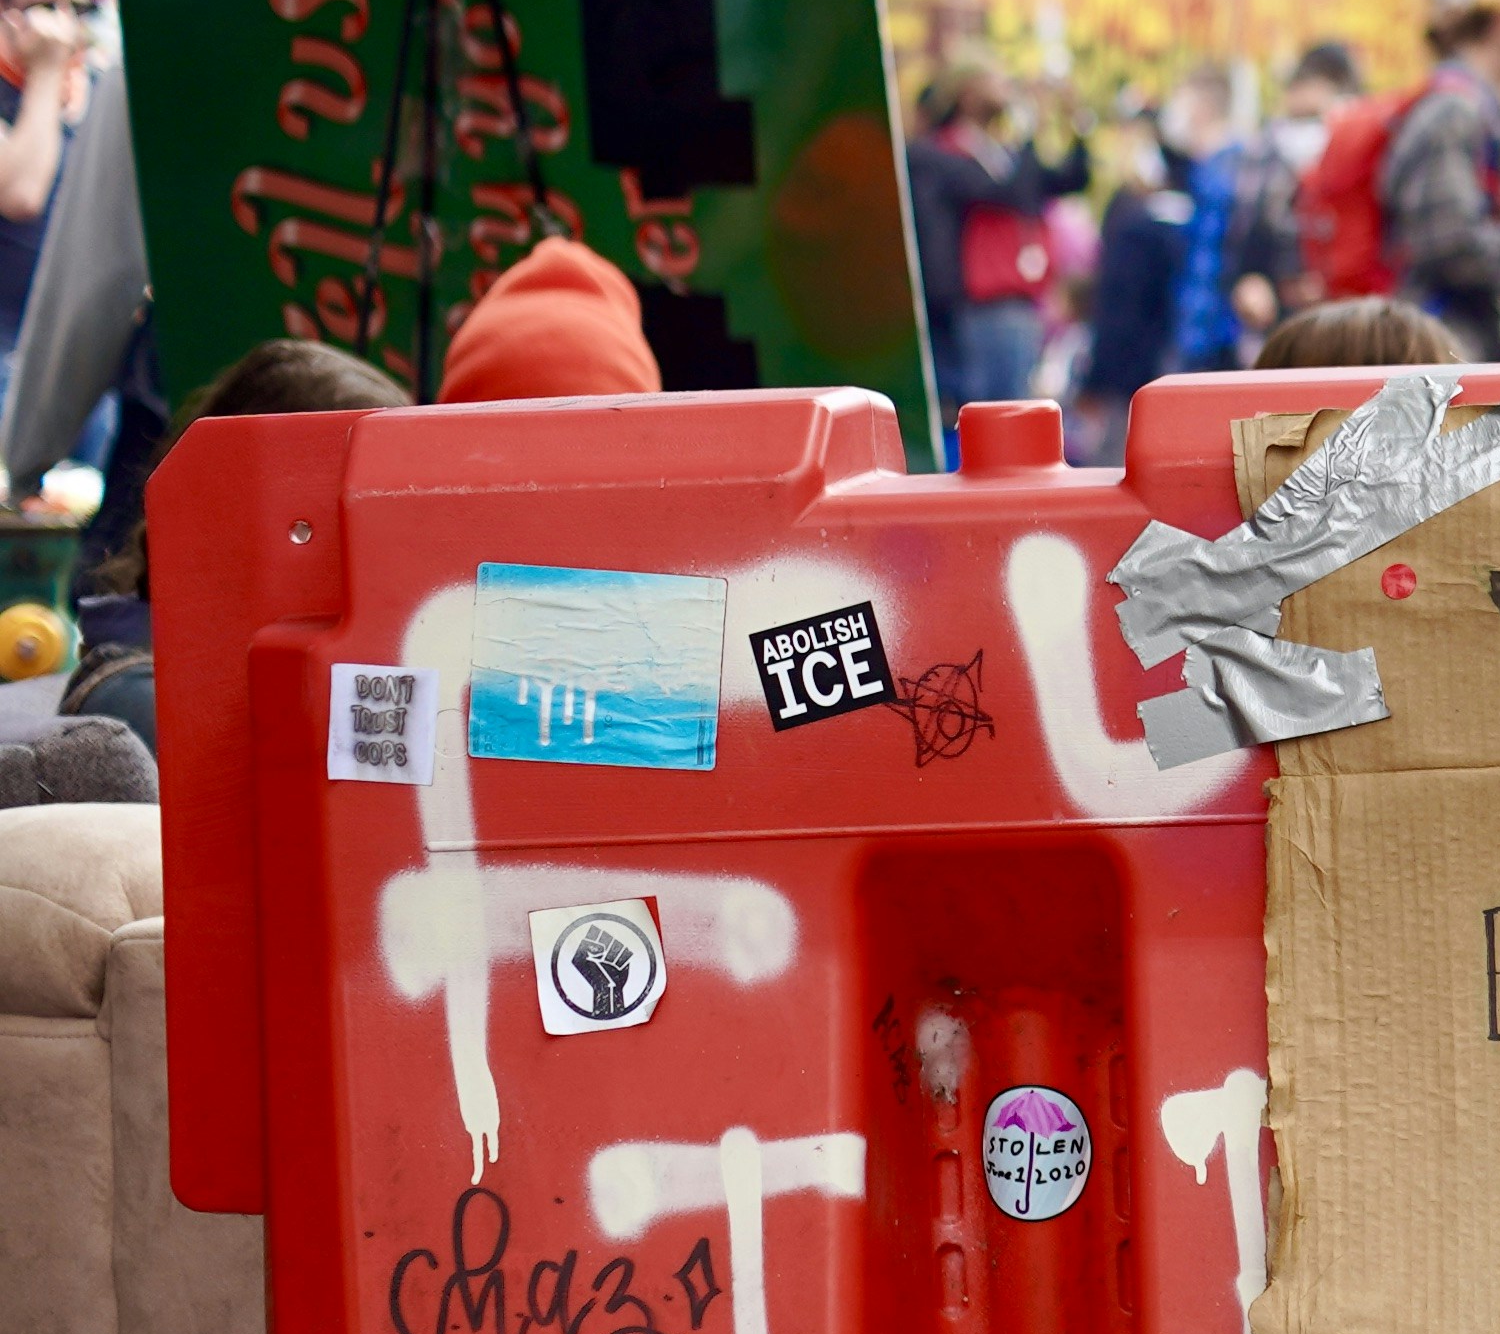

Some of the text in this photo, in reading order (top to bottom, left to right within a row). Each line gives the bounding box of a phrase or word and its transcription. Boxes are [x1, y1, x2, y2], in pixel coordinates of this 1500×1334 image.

[762, 612, 869, 664] ABOLISH
[355, 674, 415, 705] DONT
[766, 637, 884, 719] ICE
[350, 704, 407, 736] TRUST
[353, 740, 407, 766] COPS
[988, 1135, 1086, 1157] STOLEN
[1034, 1159, 1087, 1185] 2020
